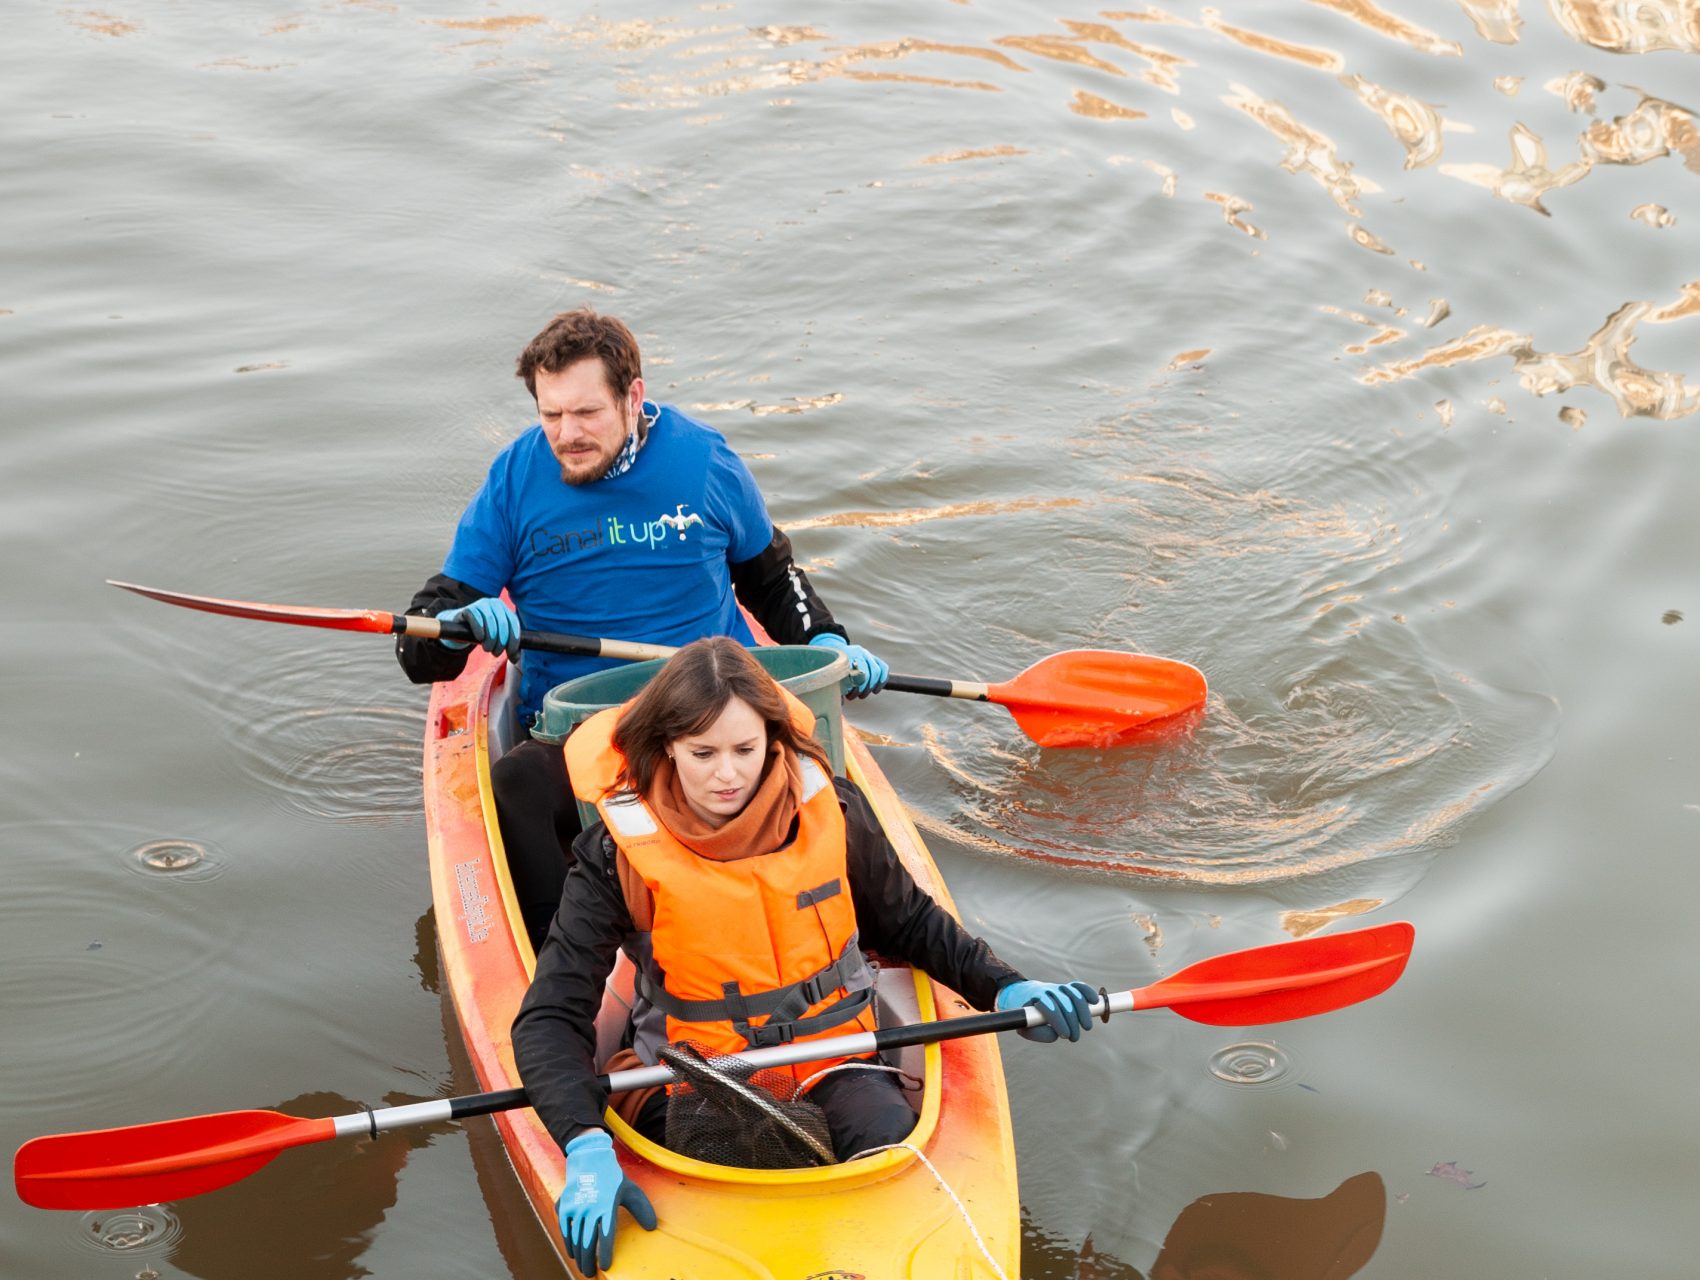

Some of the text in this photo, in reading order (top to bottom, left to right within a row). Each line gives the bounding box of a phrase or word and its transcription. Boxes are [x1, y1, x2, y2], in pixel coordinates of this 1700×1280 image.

[530, 516, 667, 557] Canal it up
